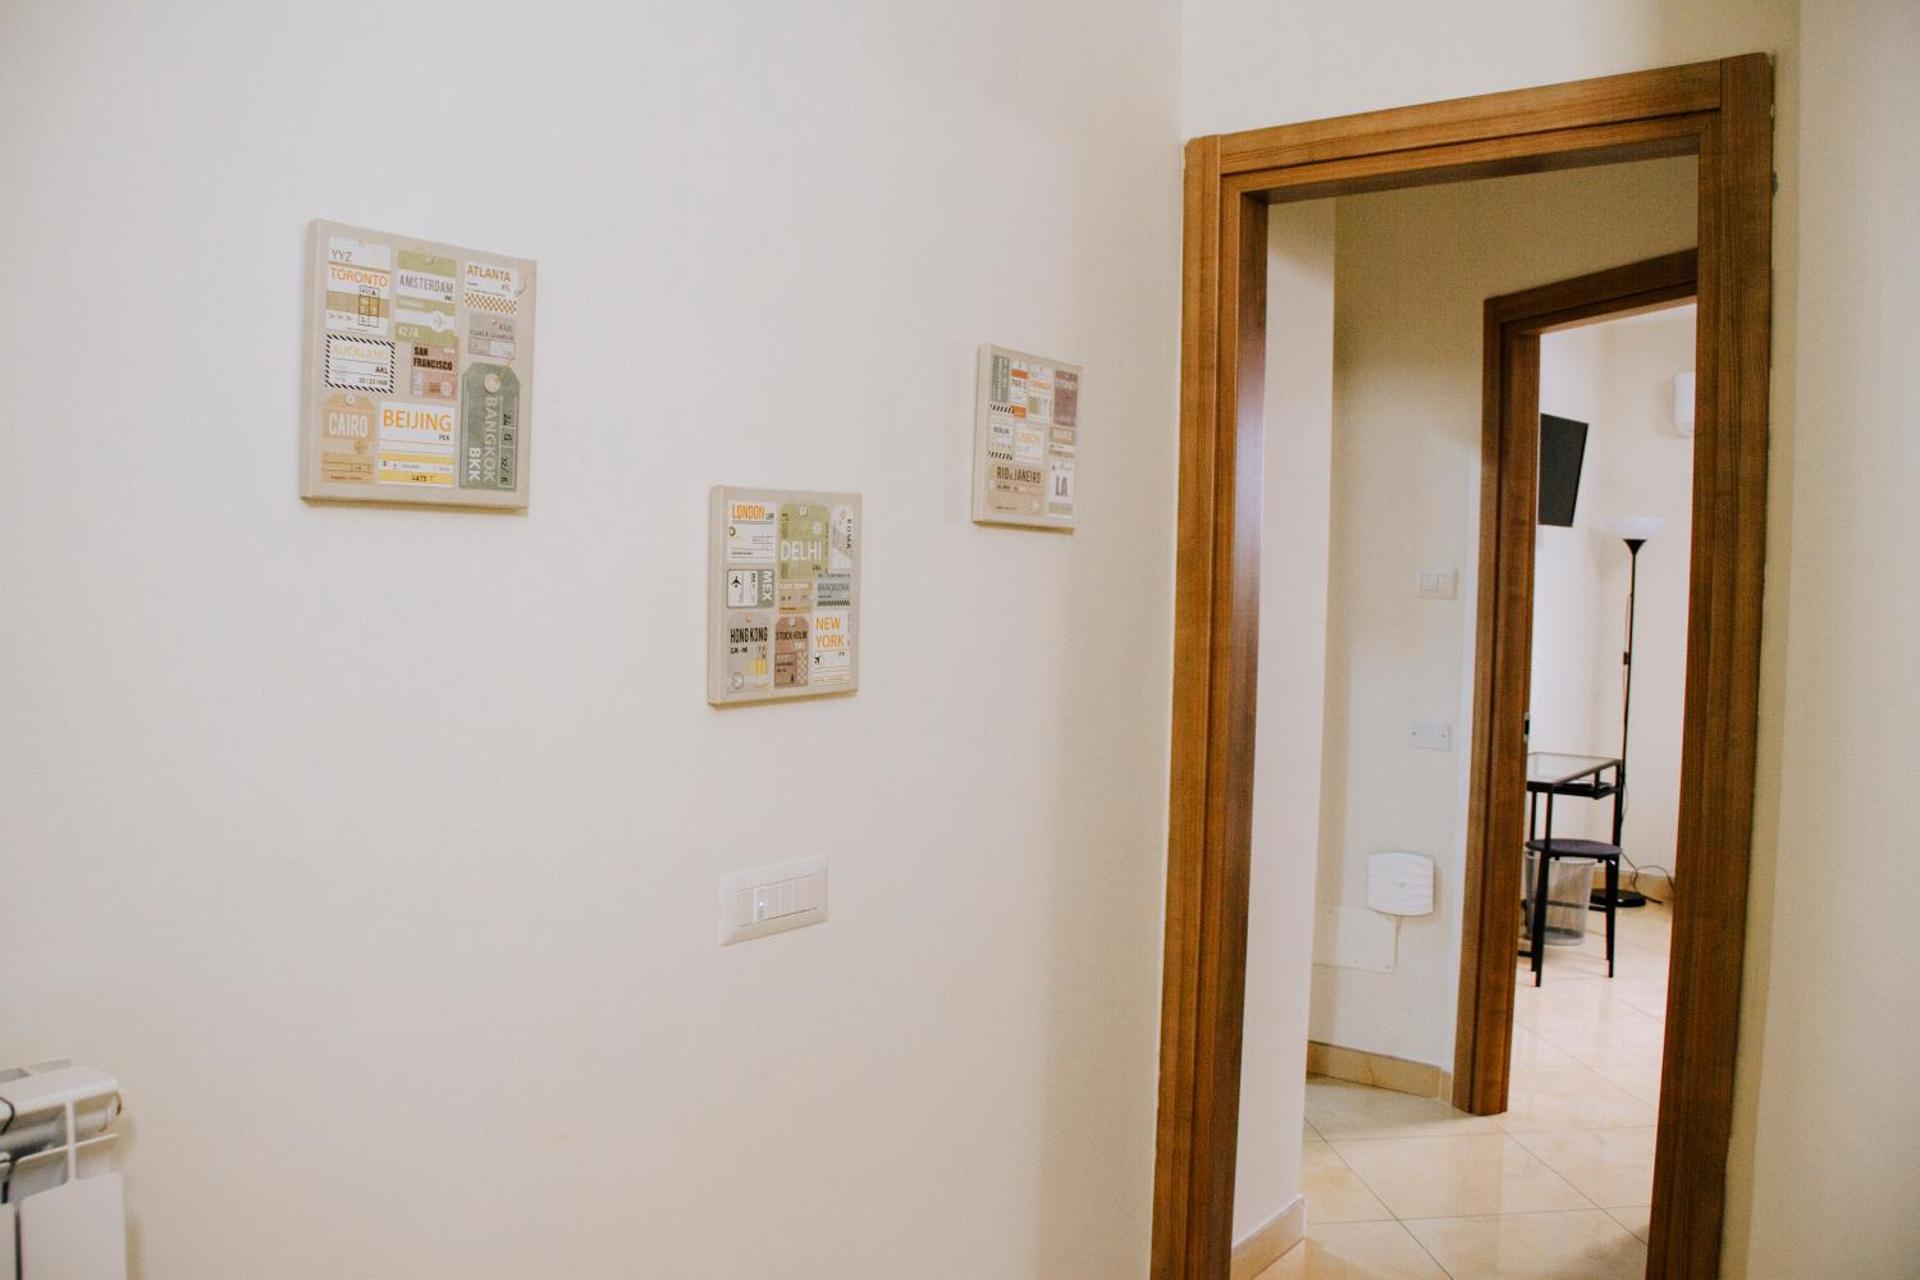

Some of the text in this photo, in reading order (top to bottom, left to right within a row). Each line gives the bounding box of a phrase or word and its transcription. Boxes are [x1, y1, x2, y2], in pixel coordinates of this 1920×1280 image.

[330, 247, 352, 261] YYZ
[330, 266, 388, 288] TORONTO
[466, 264, 511, 282] ATLANTA
[400, 273, 453, 293] AMSTERDAM
[414, 346, 429, 356] SAN
[375, 366, 389, 374] AKL
[413, 357, 453, 371] FRANCISCO
[329, 412, 368, 437] CAIRO
[383, 408, 452, 433] BEIJING
[484, 397, 499, 481] BANGKOK
[469, 447, 481, 481] BKK
[996, 466, 1009, 480] RIO
[1013, 468, 1041, 484] JANEIRO
[1055, 475, 1068, 496] LA
[732, 503, 765, 519] LONDON
[780, 540, 822, 561] DELHI
[762, 570, 773, 601] MEX
[816, 616, 841, 630] NEW
[730, 627, 768, 643] HONG KONG
[816, 634, 845, 648] YORK
